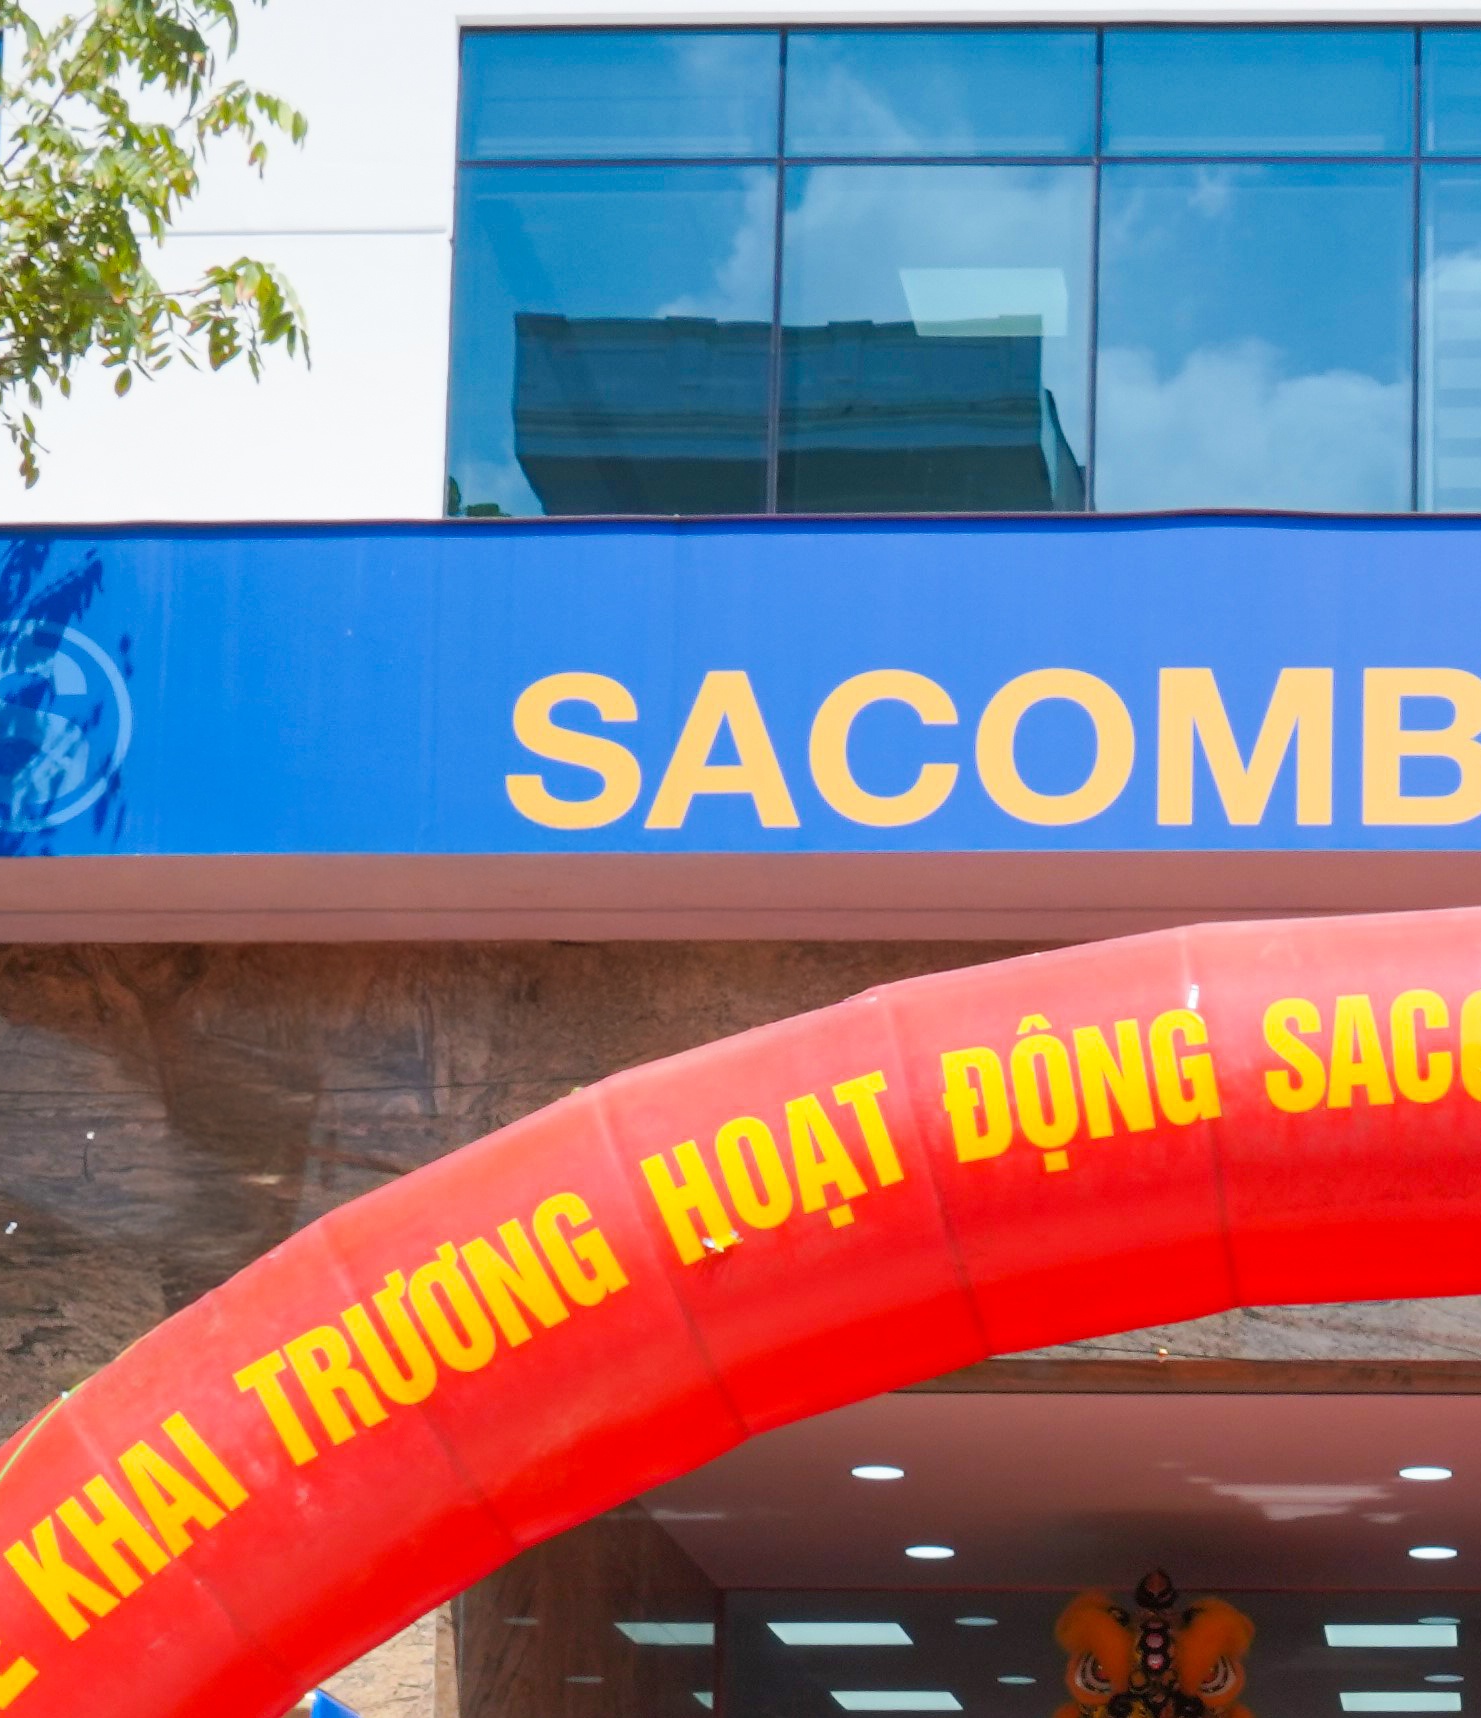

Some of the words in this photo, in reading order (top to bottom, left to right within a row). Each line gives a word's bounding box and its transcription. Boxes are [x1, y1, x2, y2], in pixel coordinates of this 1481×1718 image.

[4, 1411, 250, 1641] KHAI
[232, 1192, 629, 1466] TRƯƠNG
[639, 1070, 904, 1266] HOẠT
[939, 1012, 1222, 1173] ĐỘNG
